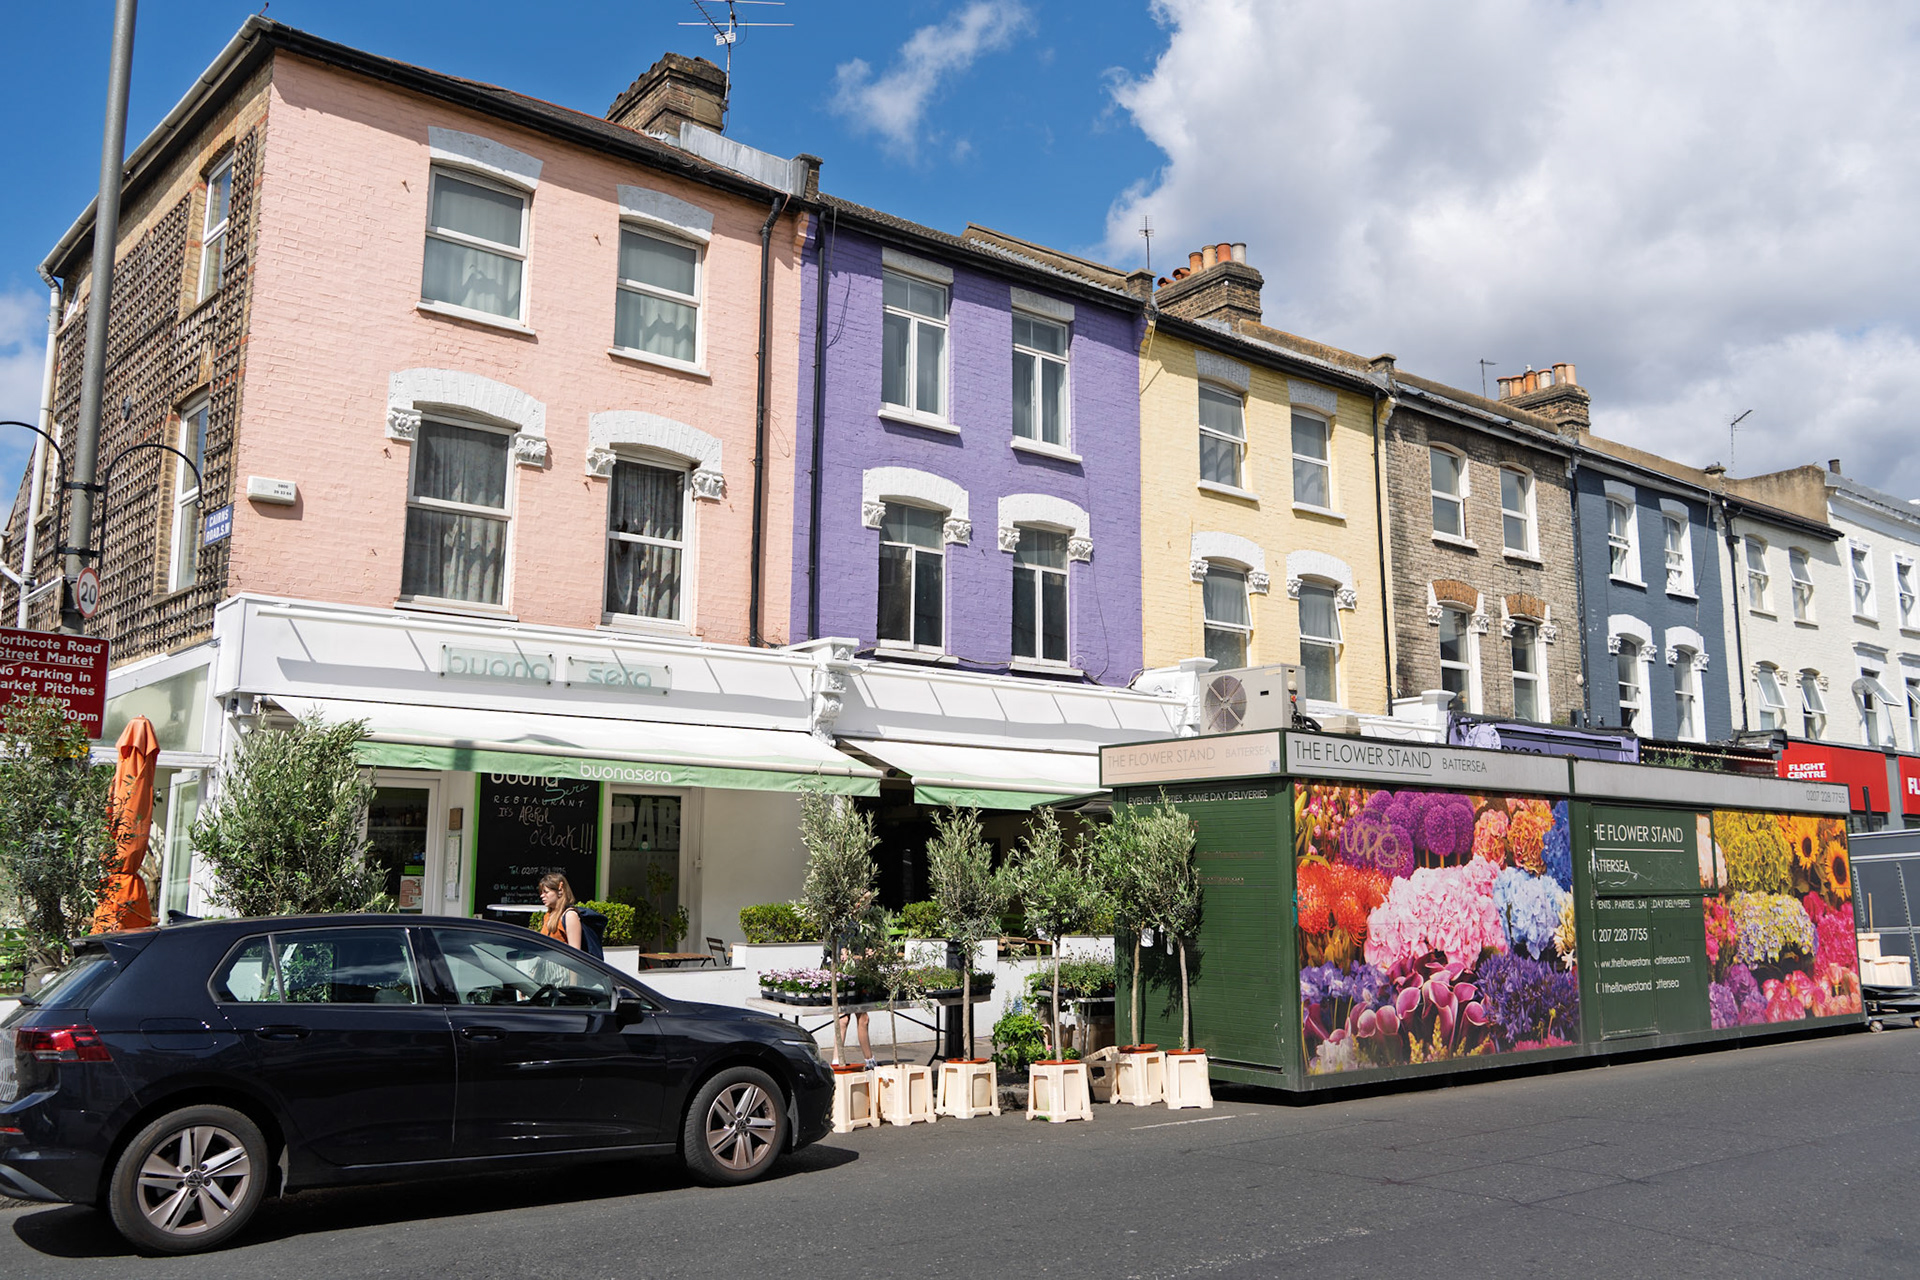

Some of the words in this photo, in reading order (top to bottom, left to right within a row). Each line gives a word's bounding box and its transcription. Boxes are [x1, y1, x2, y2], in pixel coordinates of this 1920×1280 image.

[209, 509, 229, 527] CAIRNS
[81, 581, 97, 605] 20
[0, 634, 61, 649] orthcote
[67, 641, 101, 654] Road
[47, 652, 94, 666] Market
[443, 646, 550, 680] buona
[585, 662, 651, 687] sera
[21, 666, 73, 682] Parking
[79, 672, 91, 682] in
[0, 680, 37, 691] arket
[44, 682, 95, 696] Pitches
[1108, 754, 1126, 768] THE
[1128, 750, 1174, 767] FLOWER
[1177, 747, 1216, 763] STAND
[1225, 745, 1272, 758] BATTERSEA
[1294, 740, 1321, 761] THE
[1325, 743, 1384, 766] FLOWER
[1387, 748, 1432, 769] STAND
[1442, 757, 1487, 773] BATTERSEA
[580, 761, 672, 783] buonasera
[1787, 770, 1827, 779] CENTRE
[1789, 762, 1826, 771] FLIGHT
[1128, 796, 1152, 805] EVENTS
[1188, 793, 1209, 802] SAME
[1210, 792, 1226, 801] DAY
[1228, 789, 1268, 800] DELIVERIES
[1592, 824, 1606, 841] HE
[1607, 824, 1650, 842] FLOWER
[1651, 826, 1684, 843] STAND
[1614, 900, 1635, 910] PARTIES
[1613, 928, 1628, 942] 228
[1629, 928, 1648, 941] 7755
